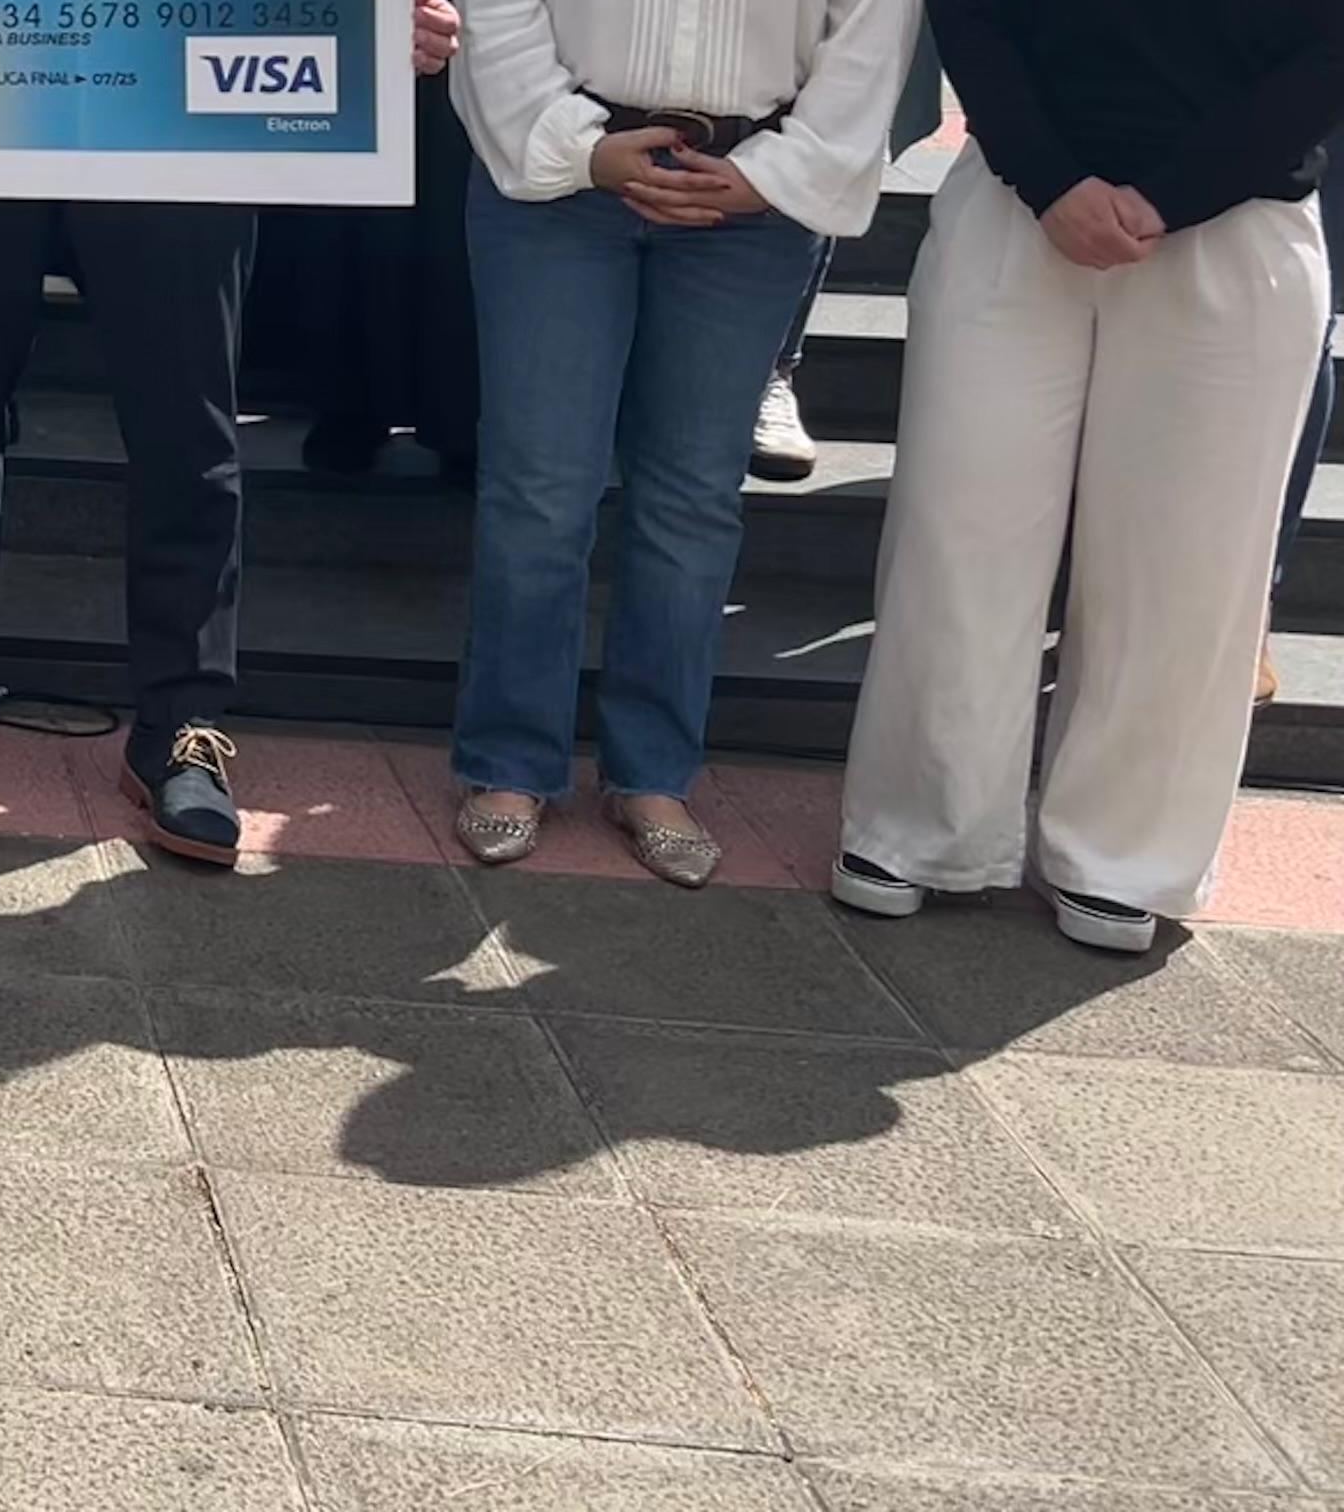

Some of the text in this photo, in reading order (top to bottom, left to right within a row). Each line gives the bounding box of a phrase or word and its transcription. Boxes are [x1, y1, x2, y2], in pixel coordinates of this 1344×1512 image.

[58, 2, 139, 28] 5678
[156, 2, 234, 28] 9012
[252, 2, 338, 27] 3456
[7, 33, 92, 46] BUSINESS
[31, 72, 69, 86] FINAL
[93, 73, 137, 86] 07/25
[200, 56, 323, 93] VISA
[266, 119, 330, 133] Electron
